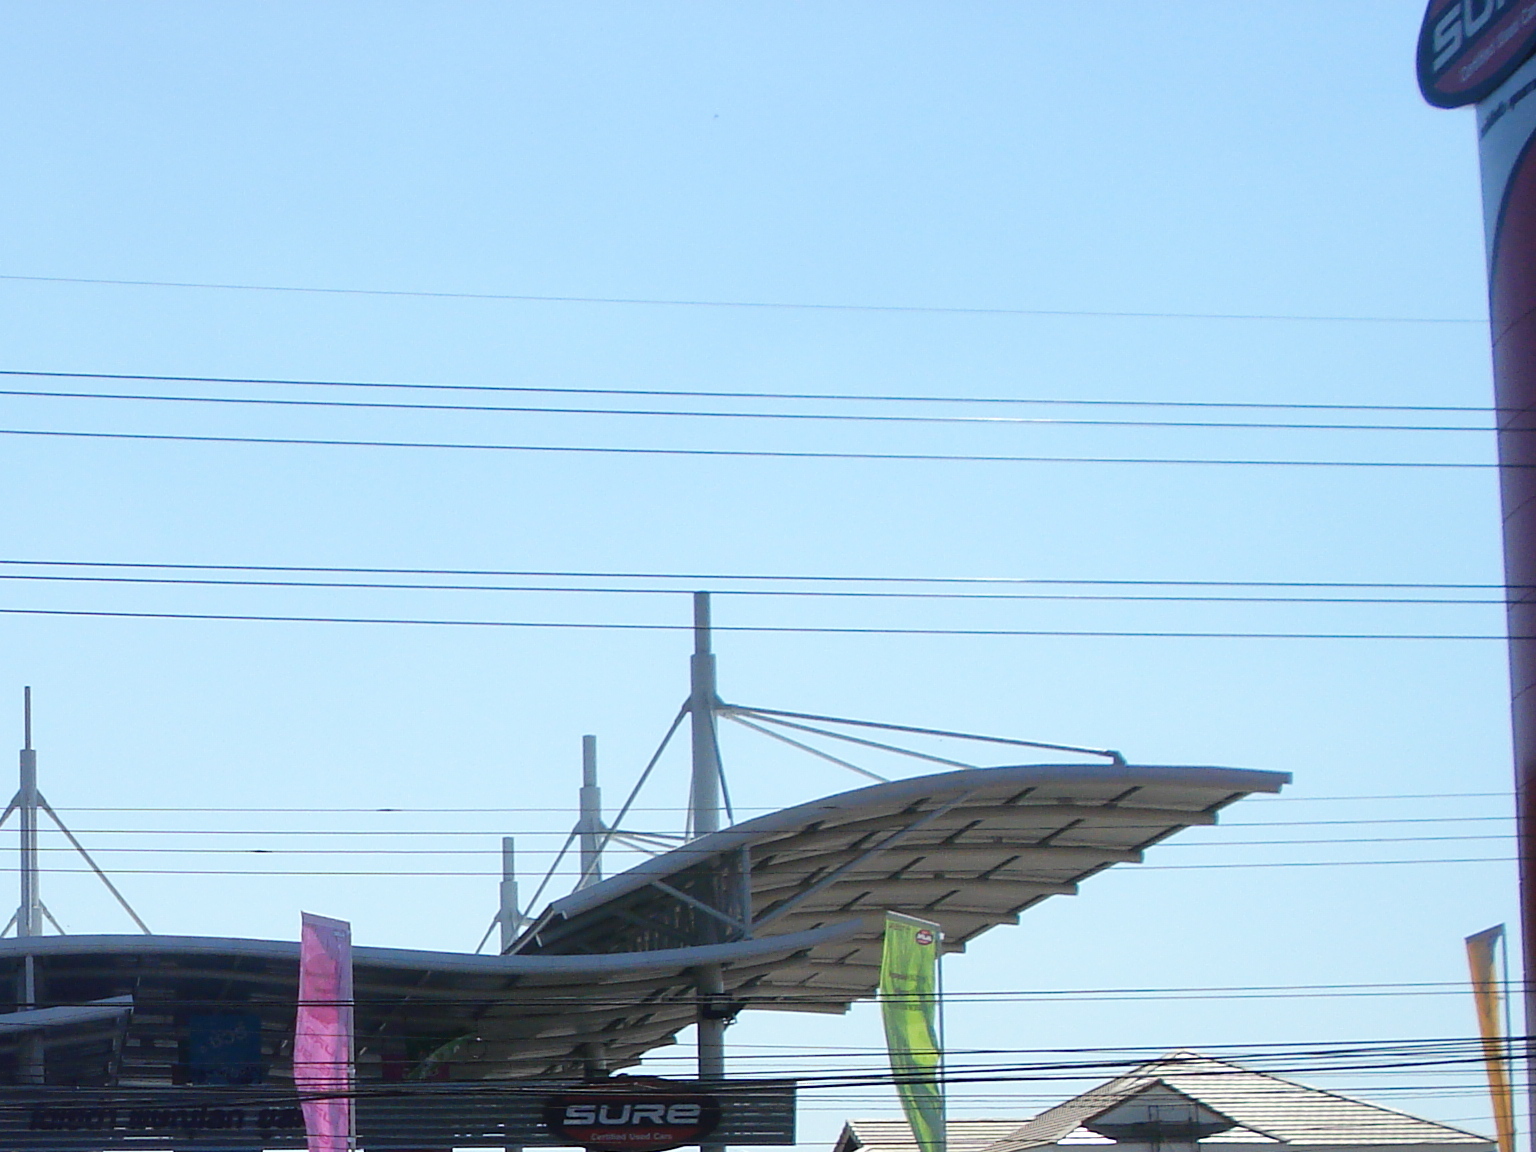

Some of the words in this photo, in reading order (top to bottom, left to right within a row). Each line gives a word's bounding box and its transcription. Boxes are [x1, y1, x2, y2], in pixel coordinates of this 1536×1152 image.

[1432, 0, 1506, 74] SU
[562, 1103, 702, 1126] SURE
[590, 1132, 627, 1142] Certified
[629, 1132, 652, 1142] Used
[653, 1132, 673, 1141] Cars
